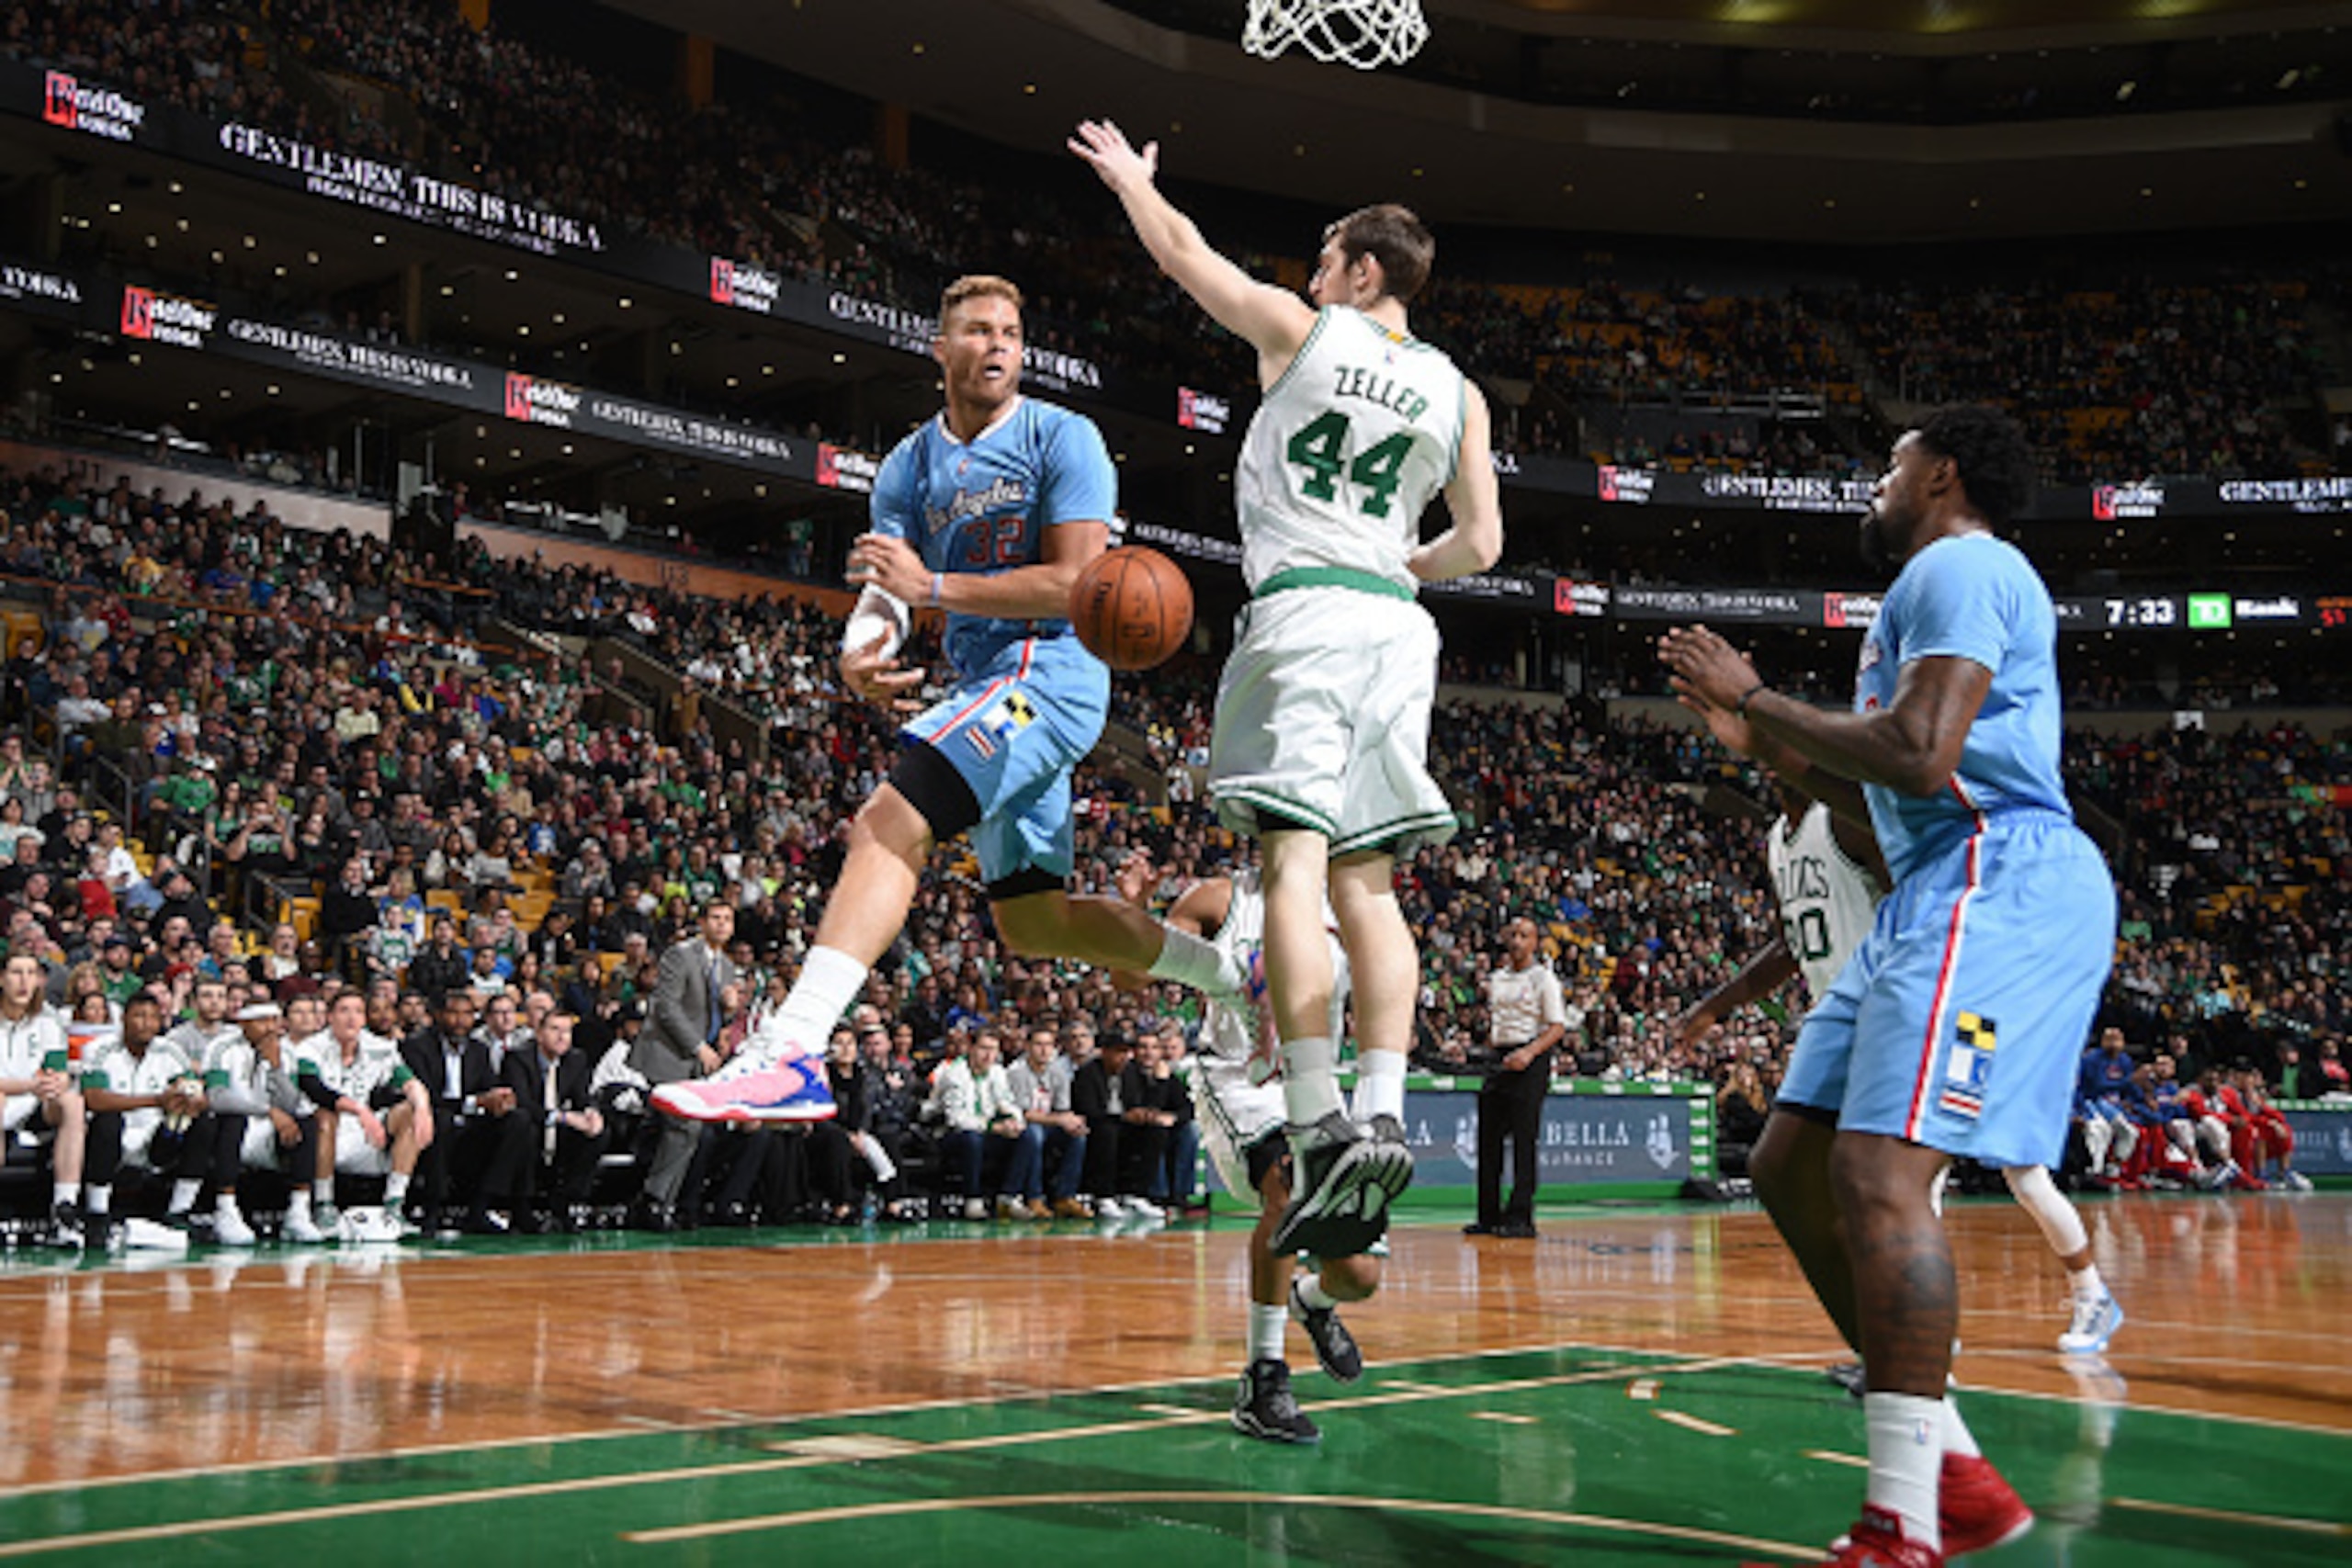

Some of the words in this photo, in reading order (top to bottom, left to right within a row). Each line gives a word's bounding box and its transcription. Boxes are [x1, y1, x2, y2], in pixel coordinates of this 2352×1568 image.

[411, 175, 478, 214] THIS
[481, 192, 506, 223] IS
[1335, 365, 1430, 423] ZELLER
[1288, 409, 1415, 519] 44
[965, 517, 1027, 565] 32
[2104, 599, 2176, 626] 7:33
[2193, 601, 2227, 622] TD
[2235, 596, 2299, 616] Bank
[1536, 1120, 1631, 1147] BELLA
